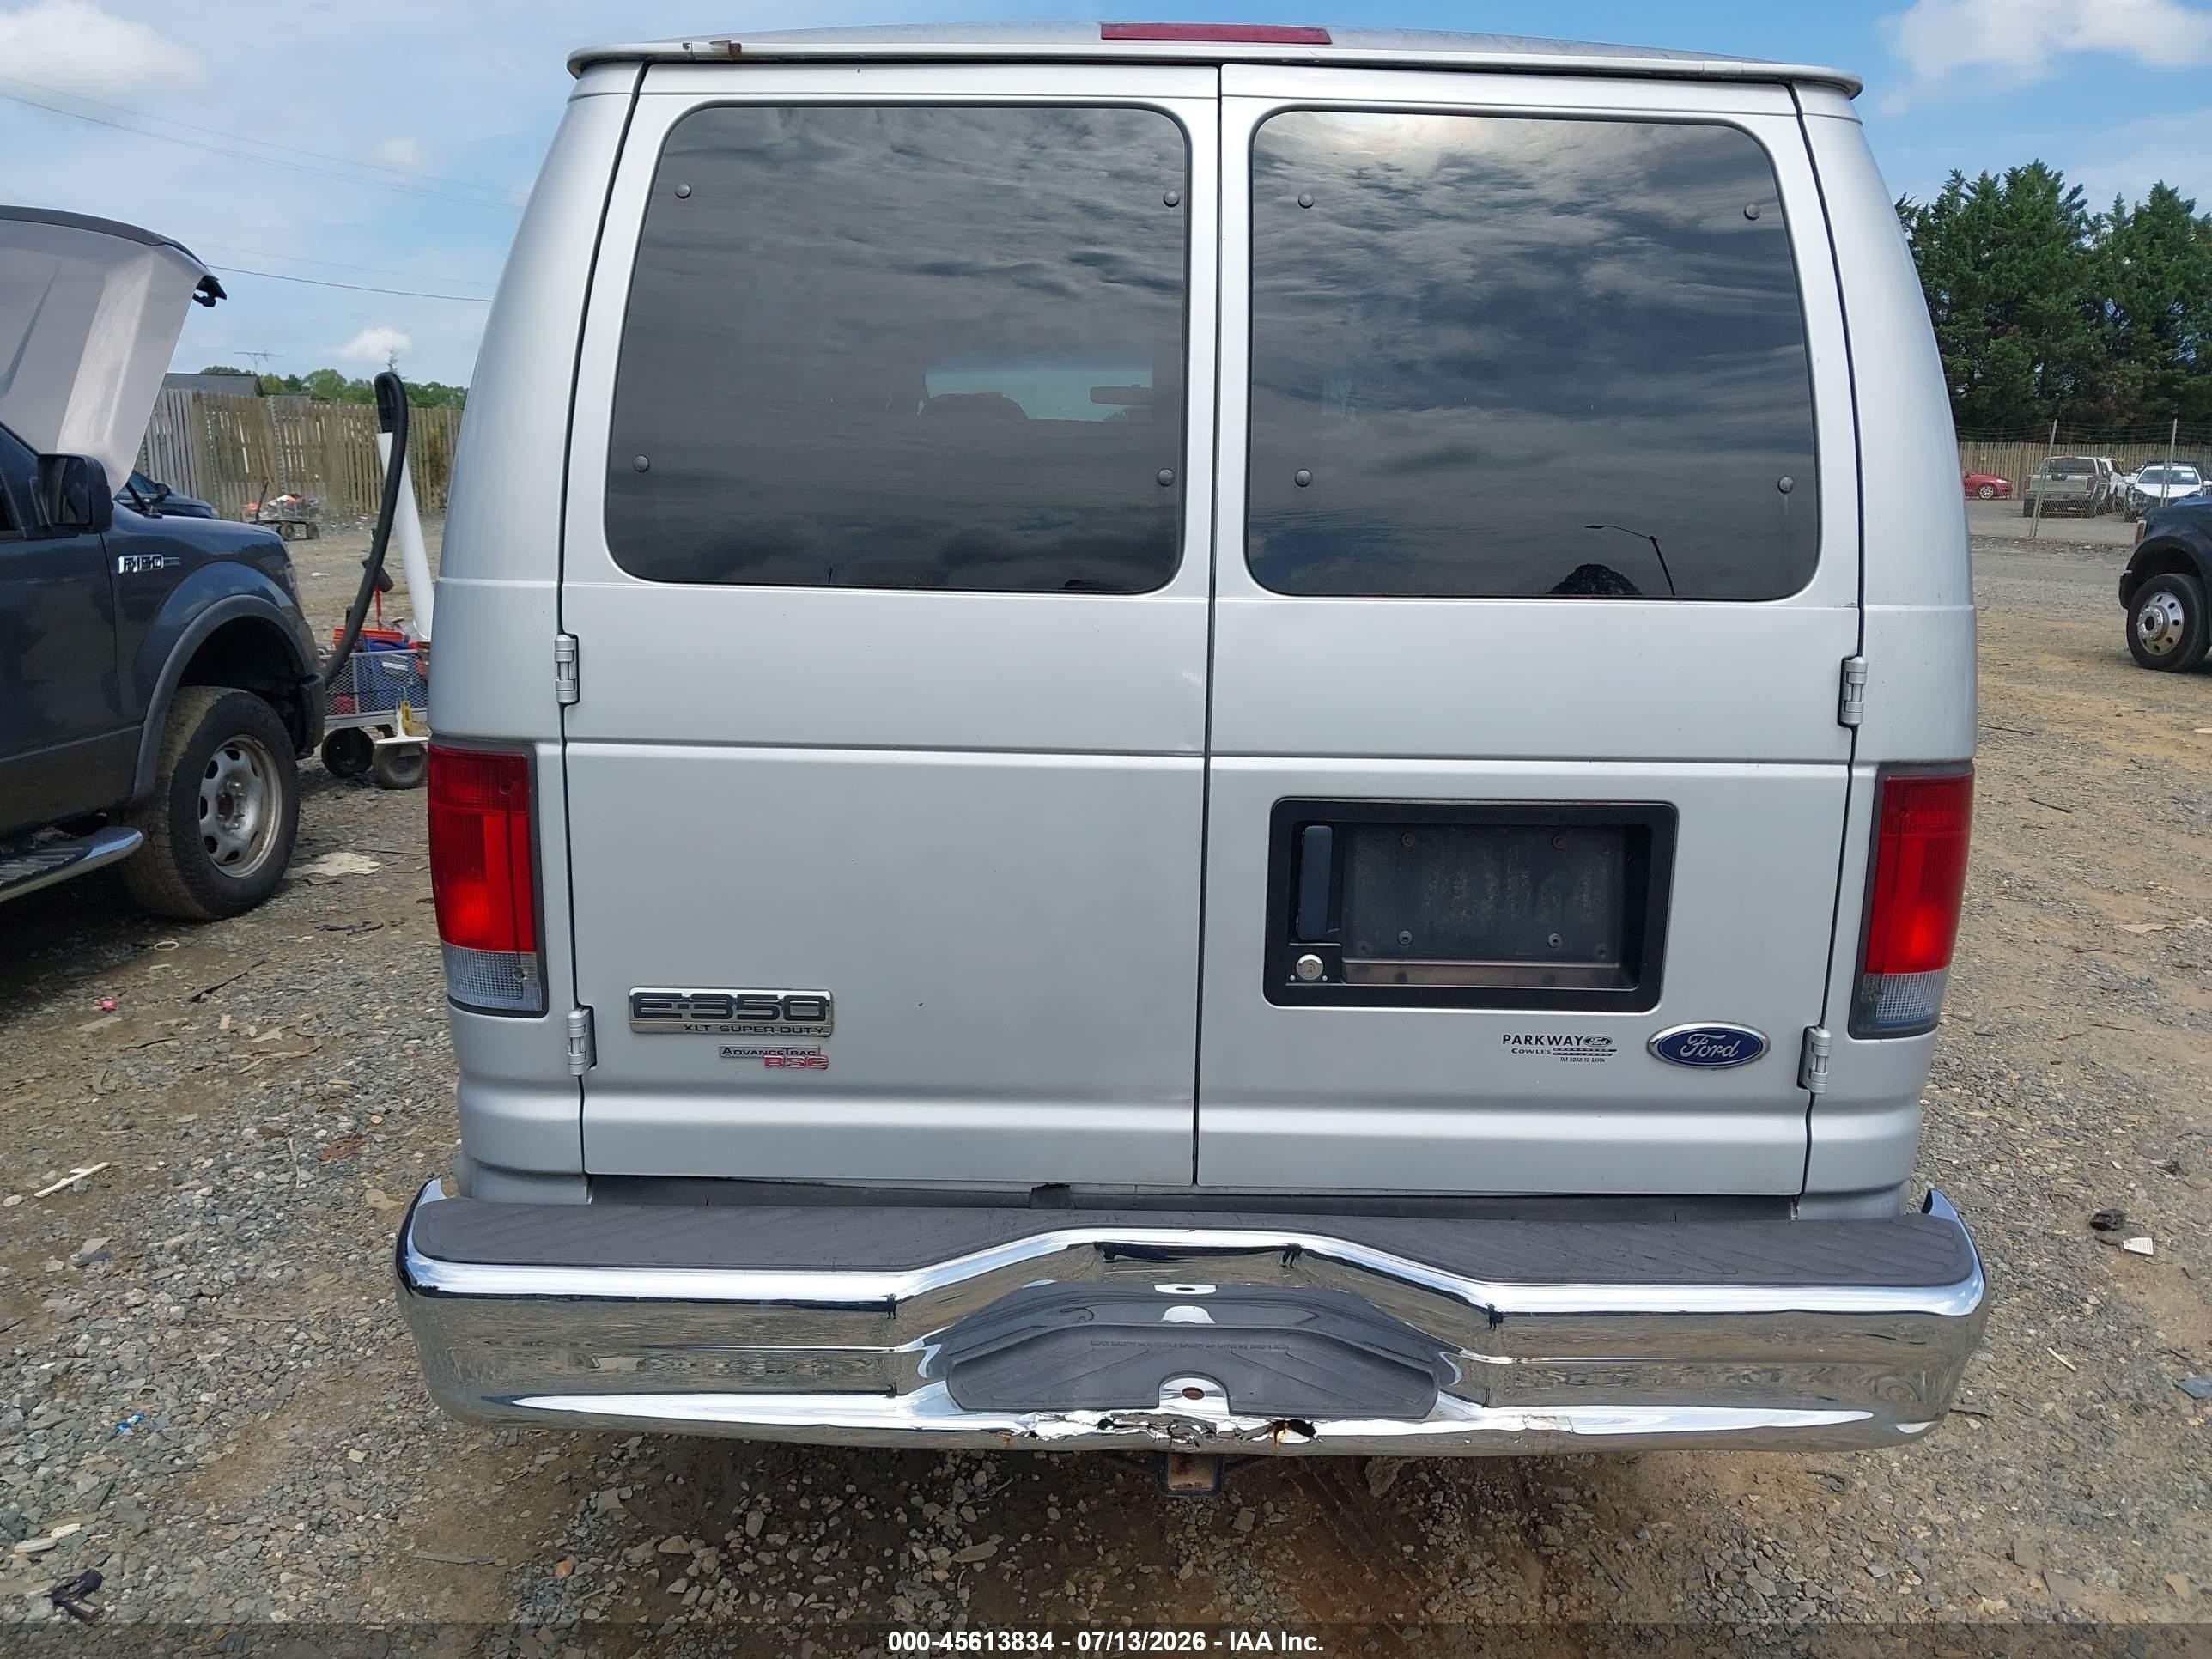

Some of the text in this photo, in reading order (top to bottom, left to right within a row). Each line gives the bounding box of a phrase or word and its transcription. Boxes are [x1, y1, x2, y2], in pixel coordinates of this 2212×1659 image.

[634, 993, 826, 1021] E-350
[684, 1024, 825, 1035] XLT SUPER DUTY
[1502, 1034, 1583, 1046] PARKWAY
[1680, 1033, 1741, 1058] Ford
[764, 1055, 829, 1070] RSC
